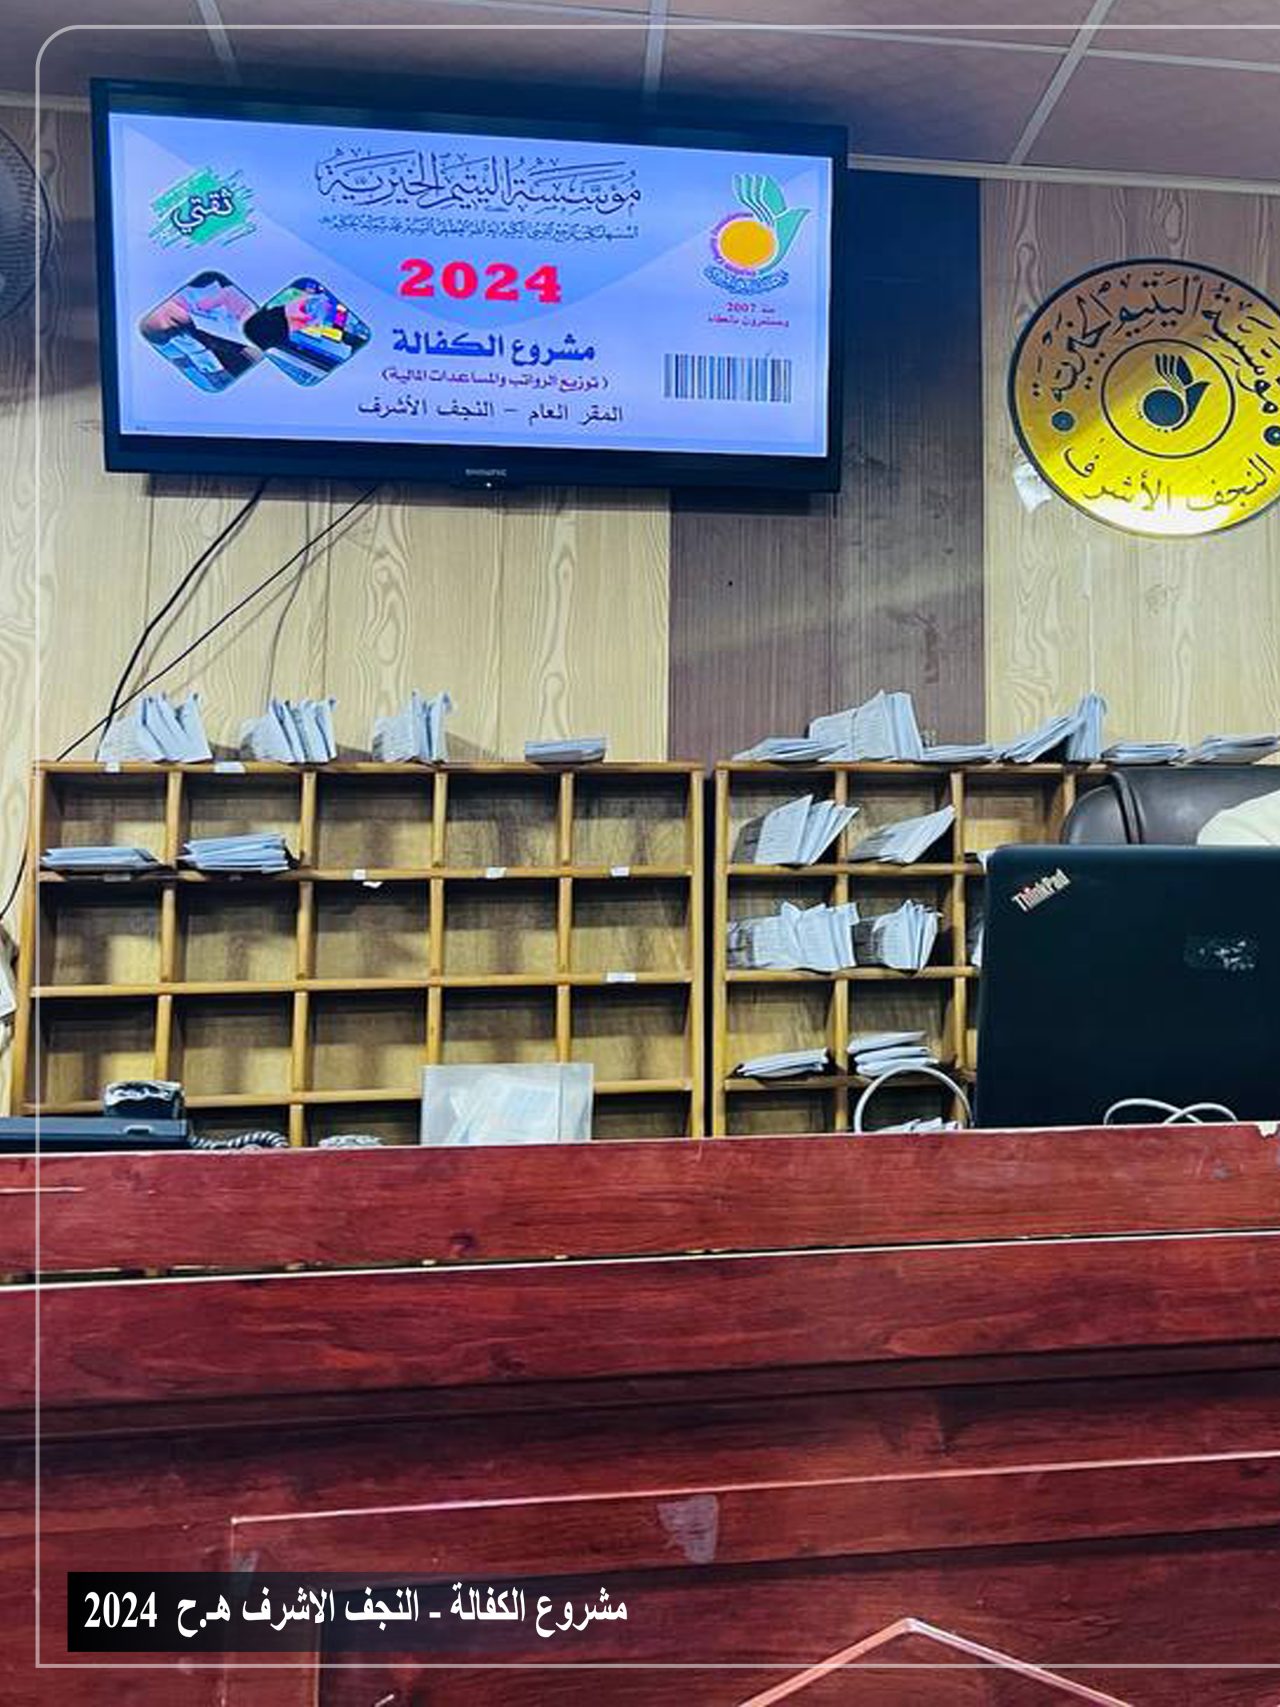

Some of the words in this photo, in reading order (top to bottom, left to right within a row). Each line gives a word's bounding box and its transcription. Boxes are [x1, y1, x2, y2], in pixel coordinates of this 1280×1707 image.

[170, 186, 234, 236] ثقتي
[399, 258, 562, 304] 2024
[393, 328, 504, 357] الكفالة
[511, 333, 595, 366] مشروع
[358, 393, 427, 418] الأشرف
[437, 399, 495, 421] النجف
[528, 402, 569, 426] العام
[579, 404, 624, 425] المقر
[1063, 445, 1171, 512] الأشرف
[1186, 451, 1277, 511] النجف
